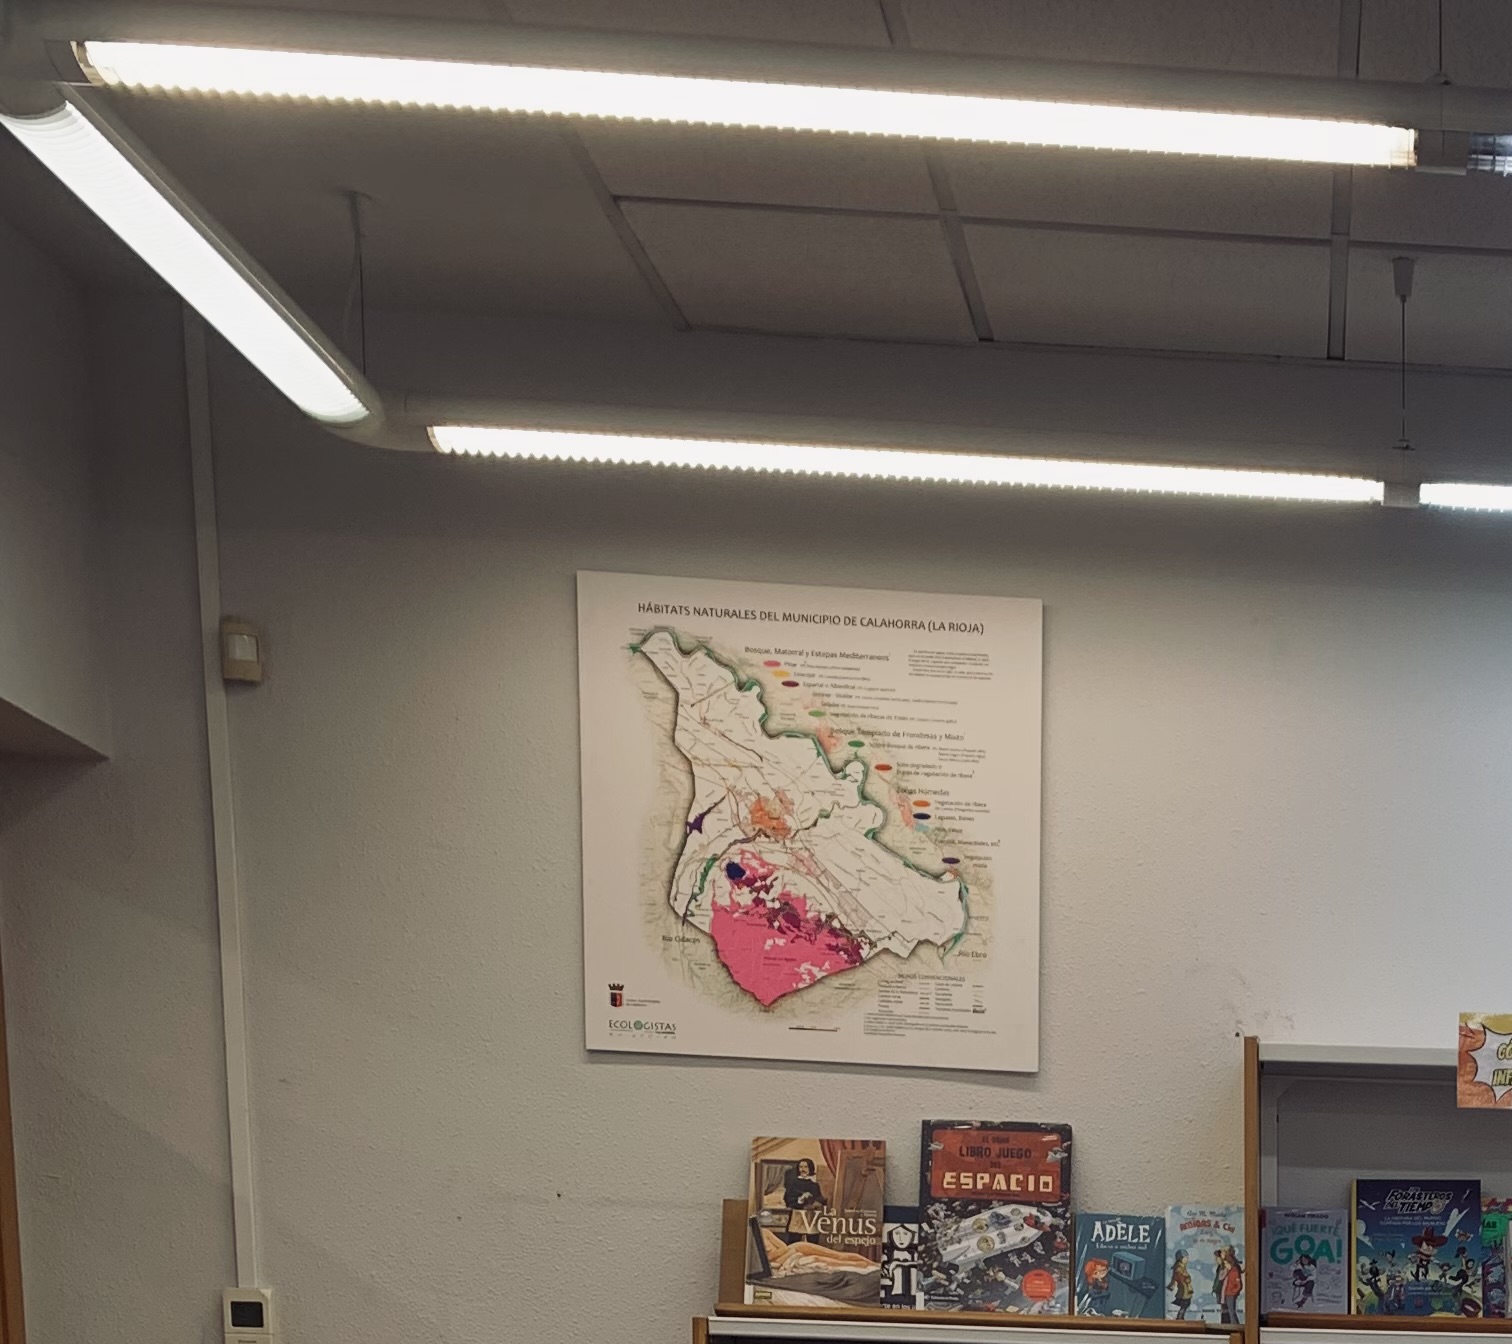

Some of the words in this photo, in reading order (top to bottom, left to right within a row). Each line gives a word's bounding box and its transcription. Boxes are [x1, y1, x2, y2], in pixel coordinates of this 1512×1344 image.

[638, 601, 690, 616] HÁBITATS
[693, 606, 757, 620] NATURALES
[760, 611, 779, 622] DEL
[782, 612, 841, 625] MUNICIPIO
[843, 616, 857, 627] DE
[860, 617, 926, 631] CALAHORRA
[928, 619, 946, 633] (LA
[948, 621, 984, 635] RIOJA)
[959, 1145, 992, 1158] LIBRO
[996, 1147, 1032, 1159] JUEGO
[943, 1172, 1053, 1192] ESPACIO
[1388, 1189, 1453, 1201] FORASTEROS
[823, 1206, 836, 1216] La
[799, 1210, 877, 1235] Venus
[827, 1235, 841, 1243] del
[844, 1236, 876, 1246] espejo
[1269, 1235, 1343, 1264] GOA!
